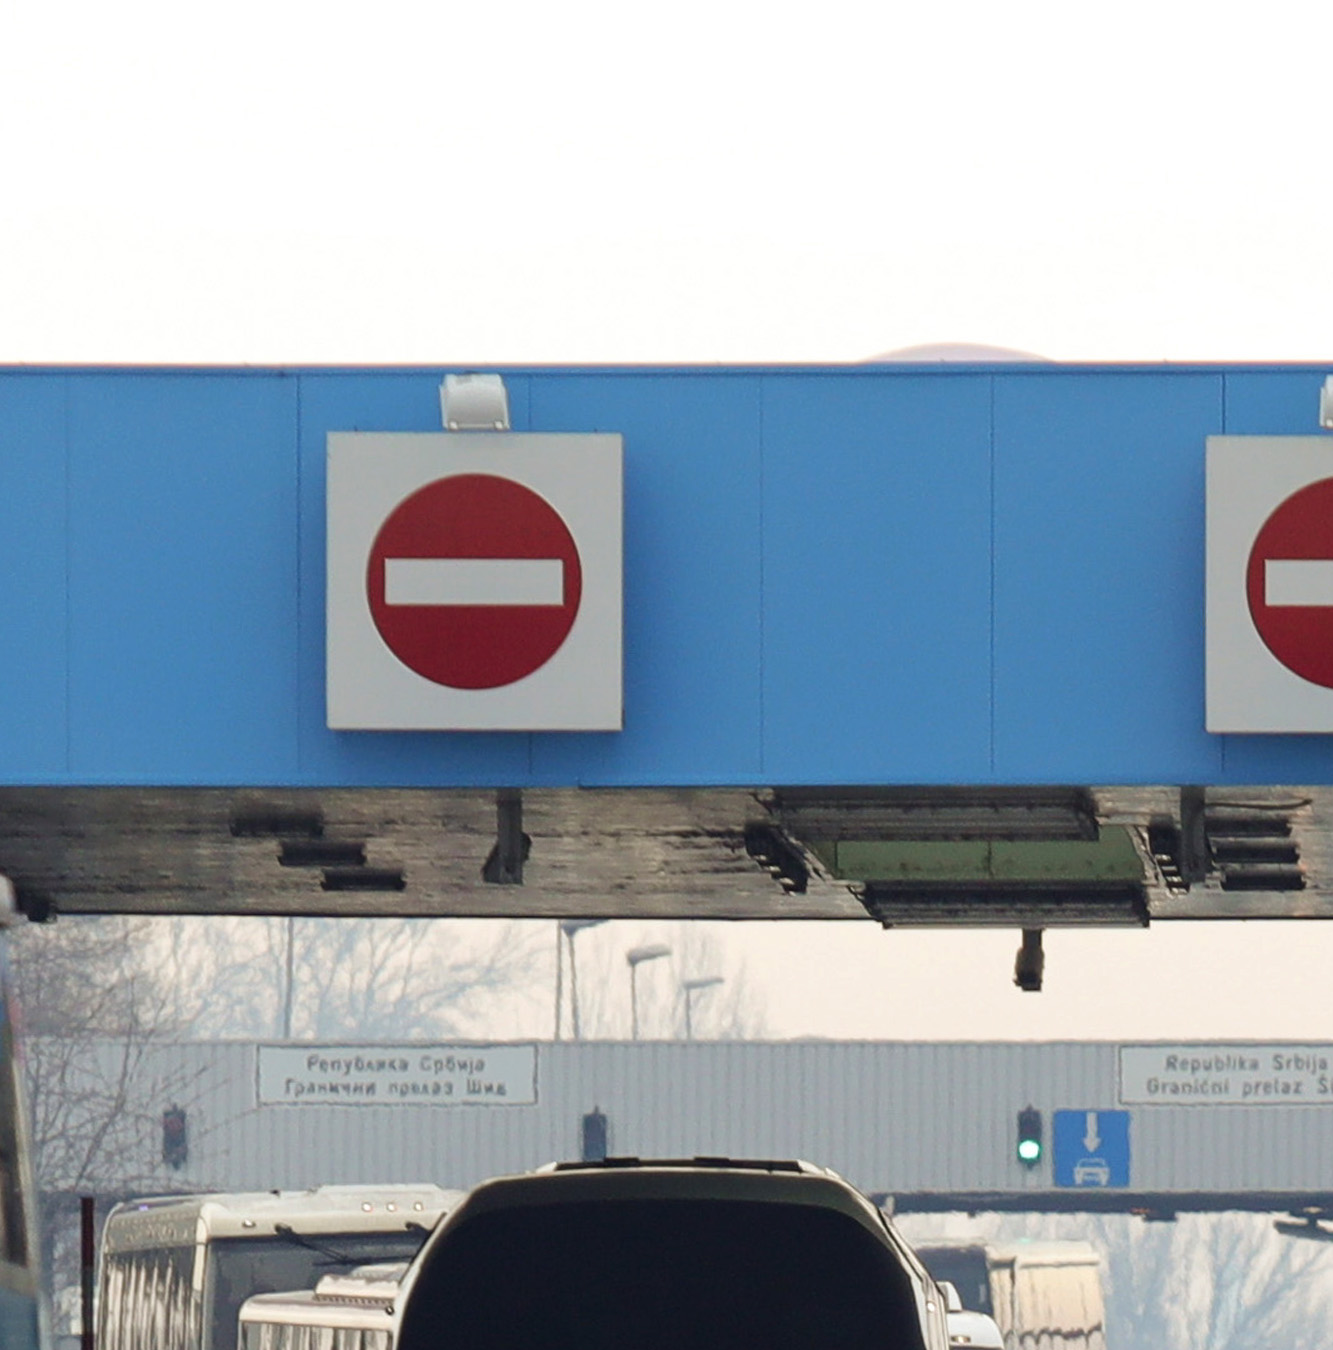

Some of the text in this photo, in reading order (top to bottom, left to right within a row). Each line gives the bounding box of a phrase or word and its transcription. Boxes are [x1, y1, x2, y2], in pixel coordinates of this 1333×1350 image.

[307, 1055, 485, 1075] Република Србија
[1165, 1053, 1329, 1075] Republika Srbija
[1241, 1077, 1304, 1098] prelaz
